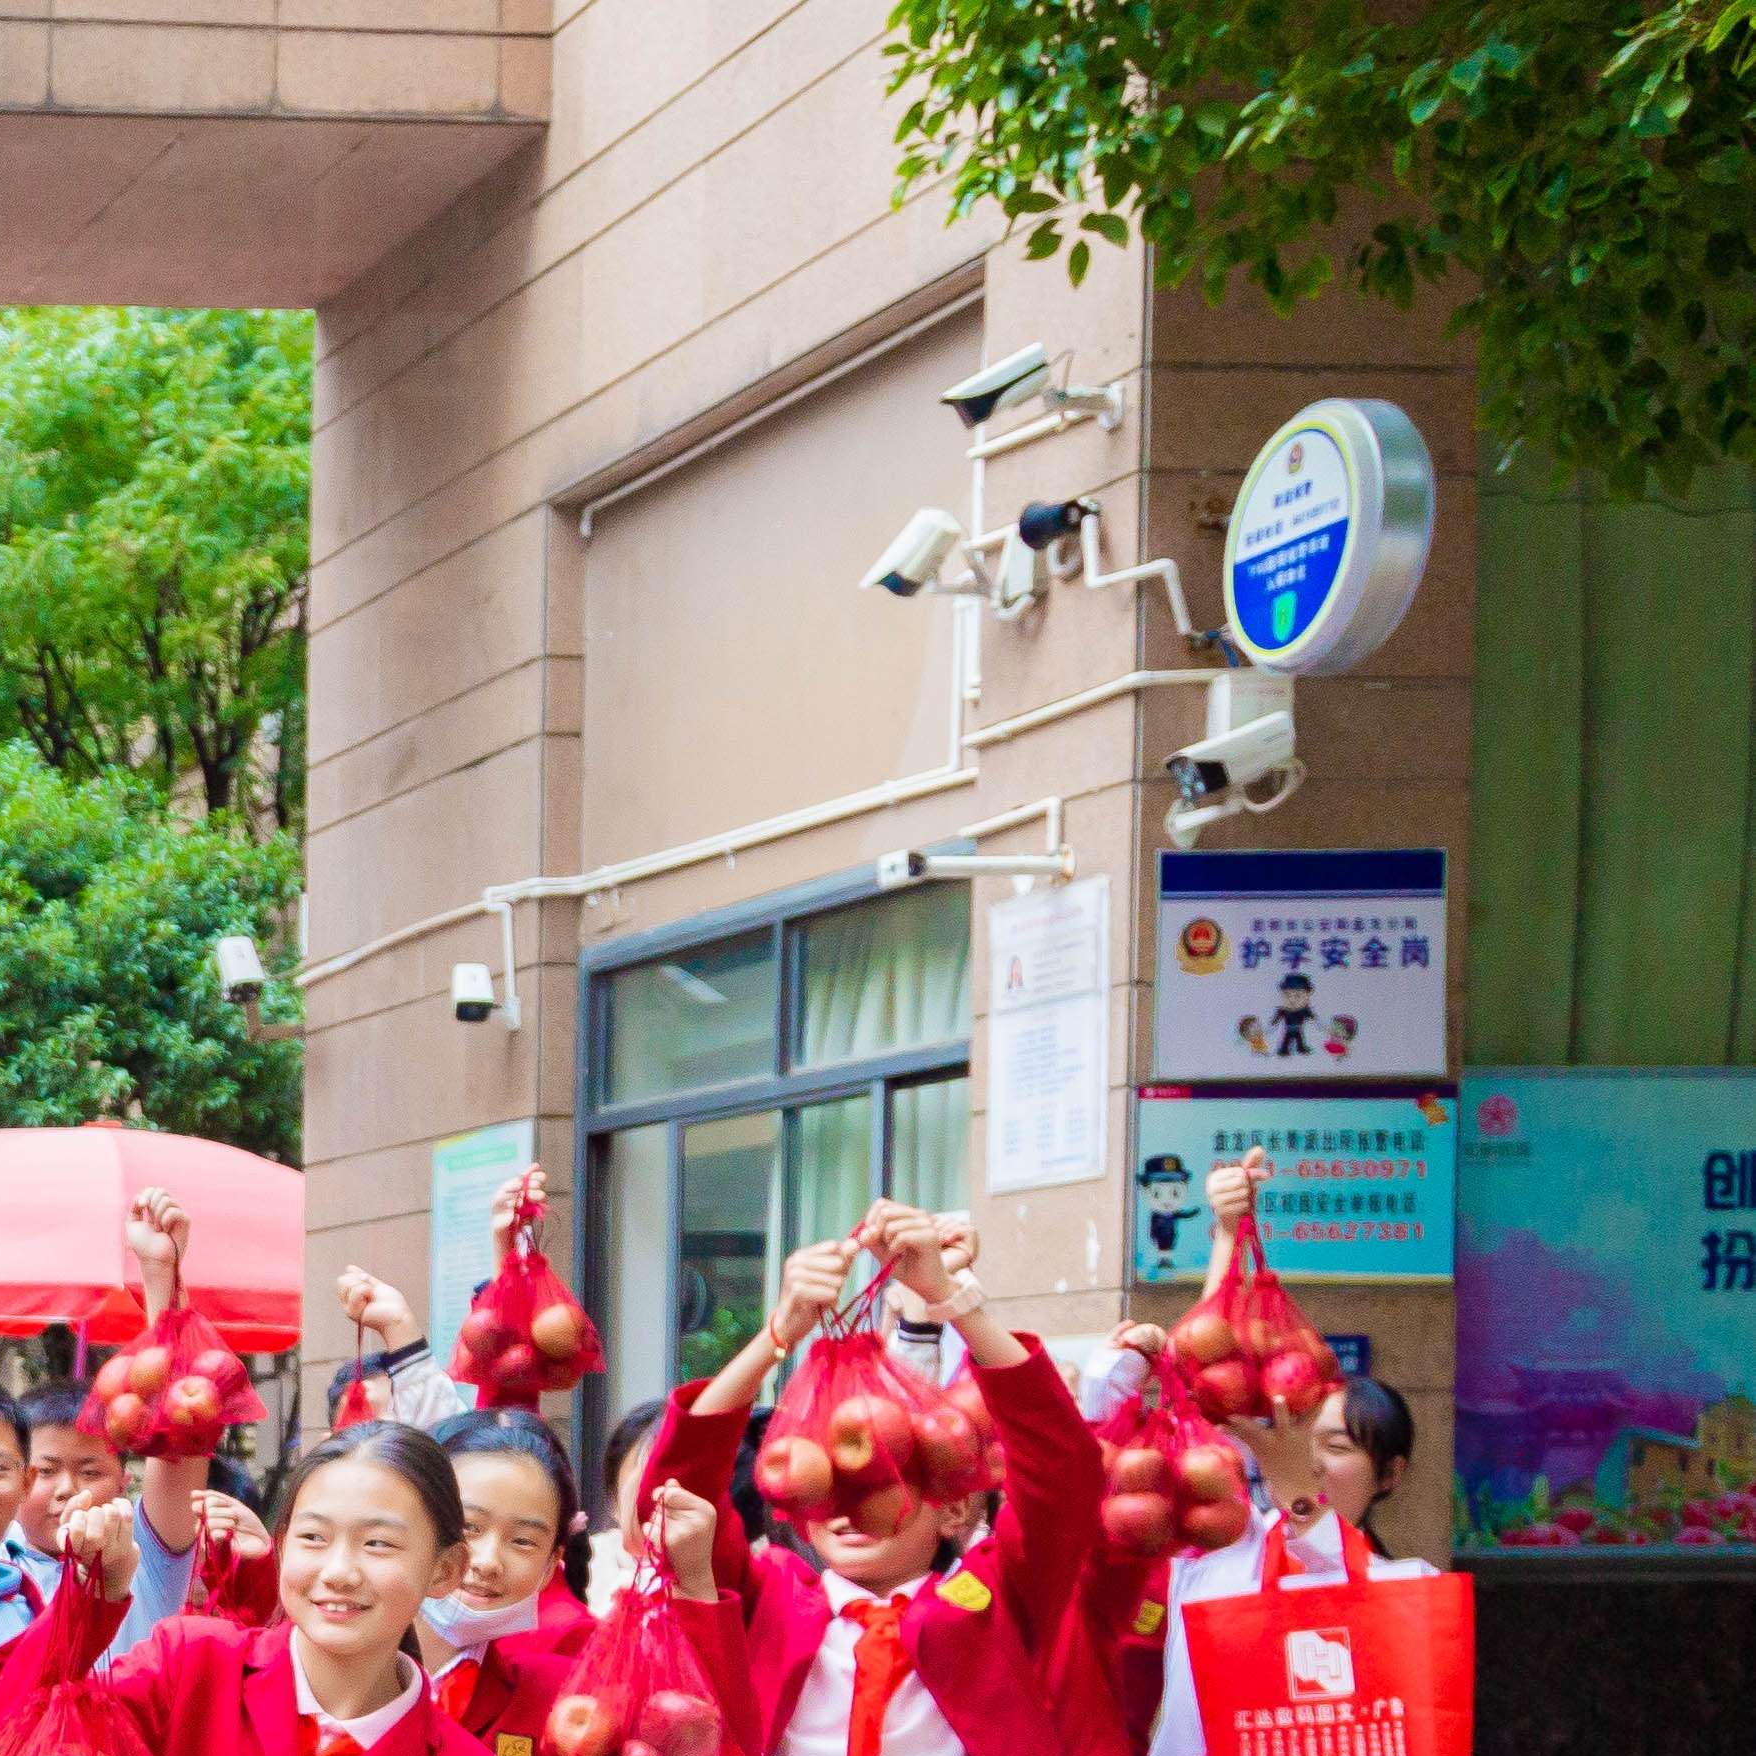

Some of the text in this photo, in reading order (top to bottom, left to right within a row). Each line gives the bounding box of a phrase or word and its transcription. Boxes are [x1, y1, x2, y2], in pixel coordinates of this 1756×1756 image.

[1241, 936, 1431, 970] 护学安全岗
